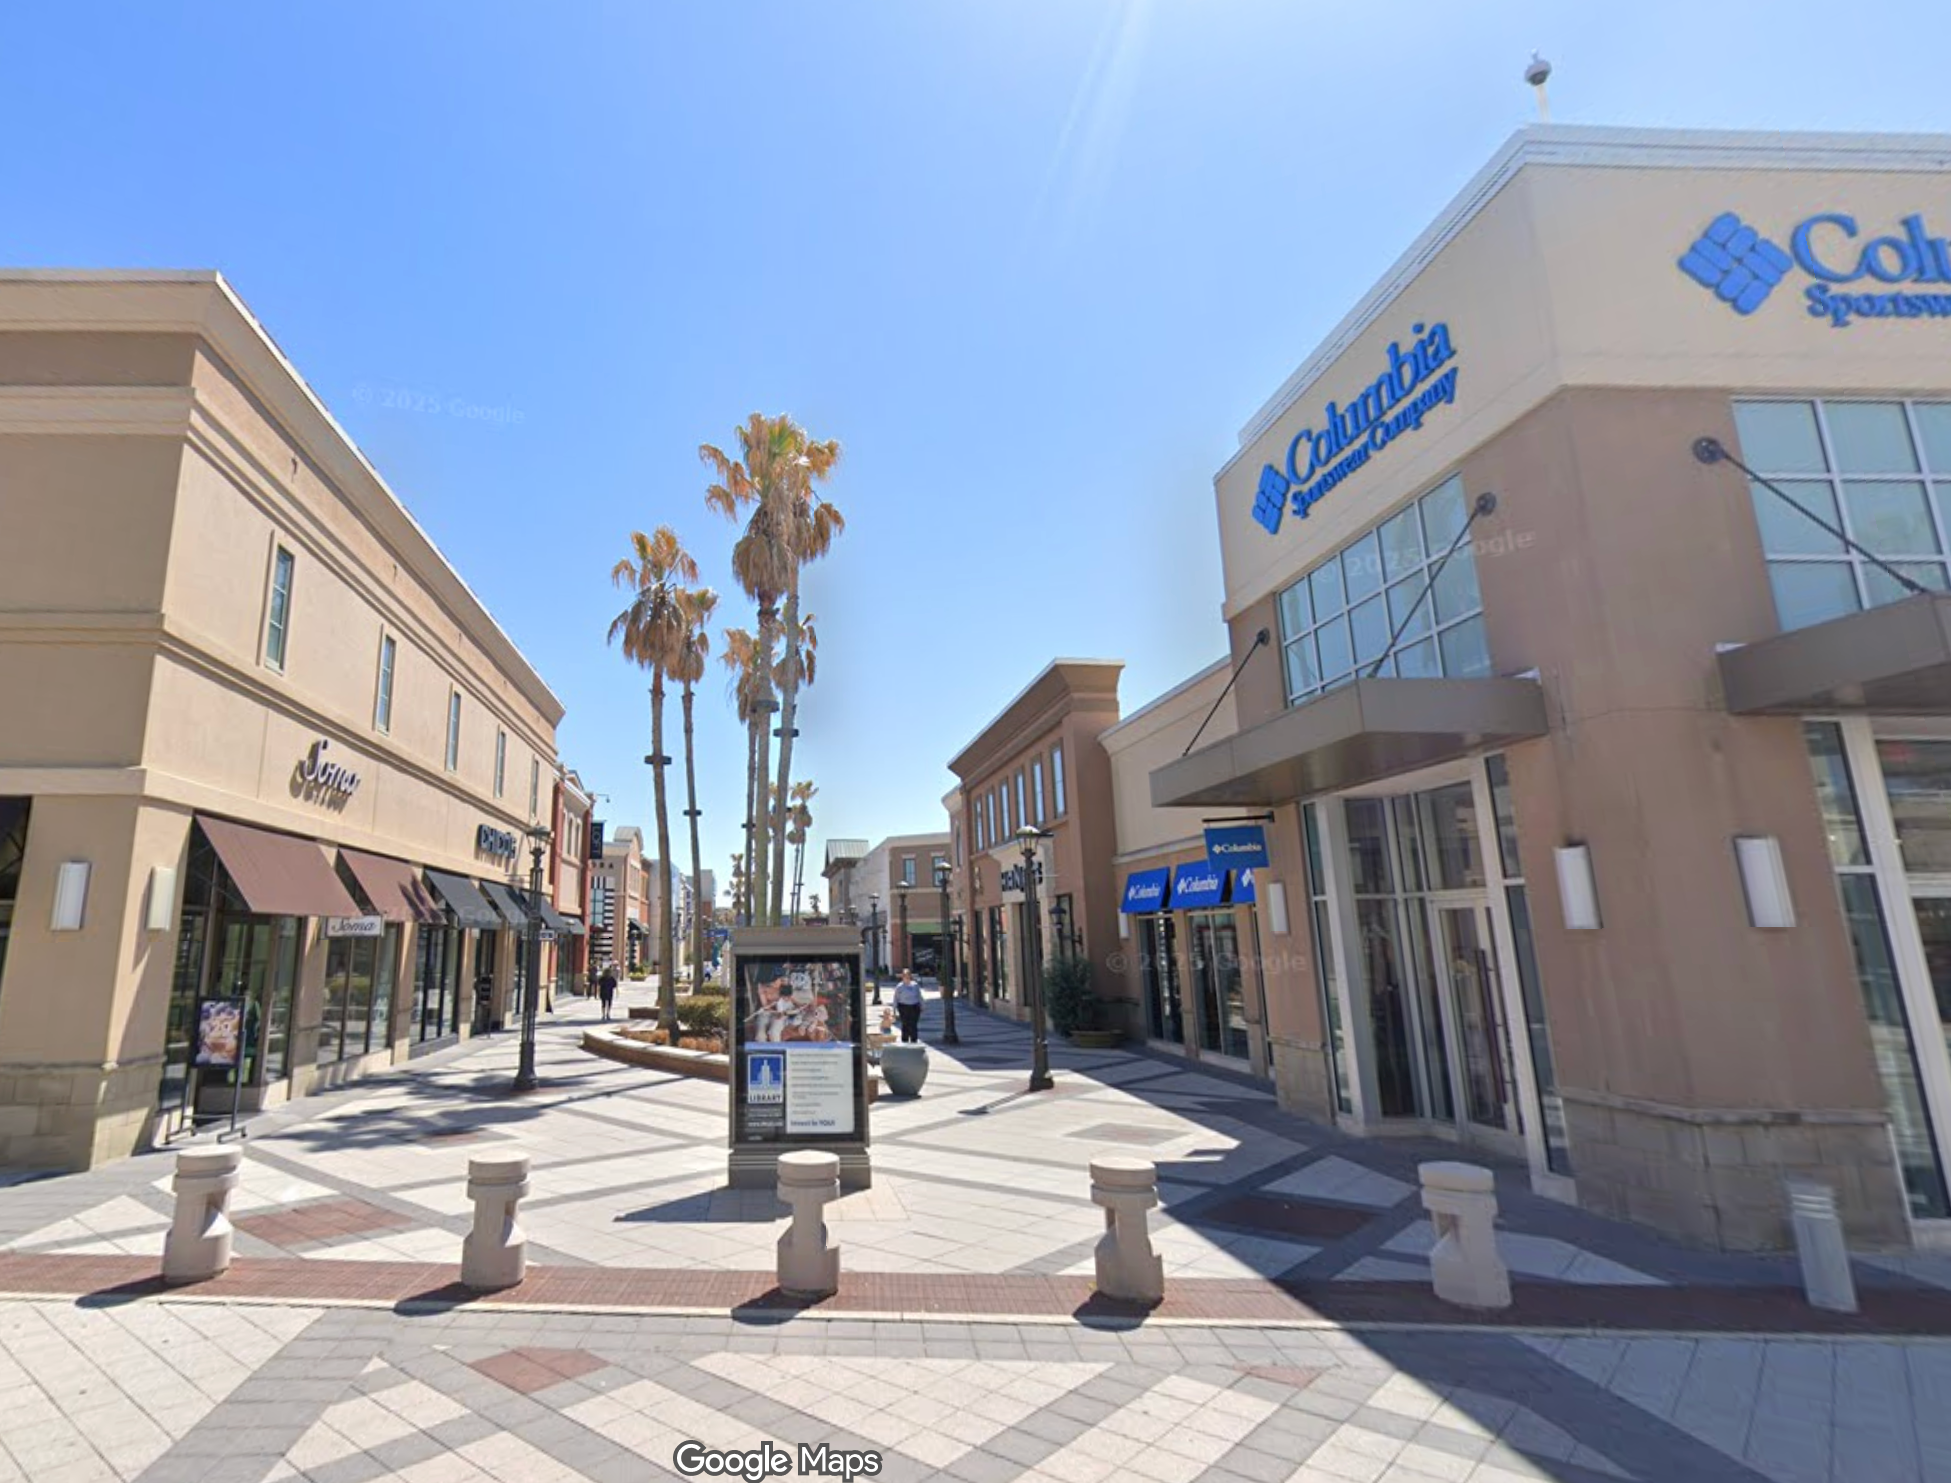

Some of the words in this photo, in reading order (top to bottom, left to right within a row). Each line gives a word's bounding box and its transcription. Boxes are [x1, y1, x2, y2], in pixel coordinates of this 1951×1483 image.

[1285, 322, 1458, 485] Columbia
[1290, 442, 1371, 519] Sportswear
[1367, 366, 1459, 452] Company
[299, 738, 361, 796] Soma
[1185, 873, 1219, 893] Columbia
[331, 918, 377, 933] Soma
[749, 1093, 781, 1101] LIBRARY
